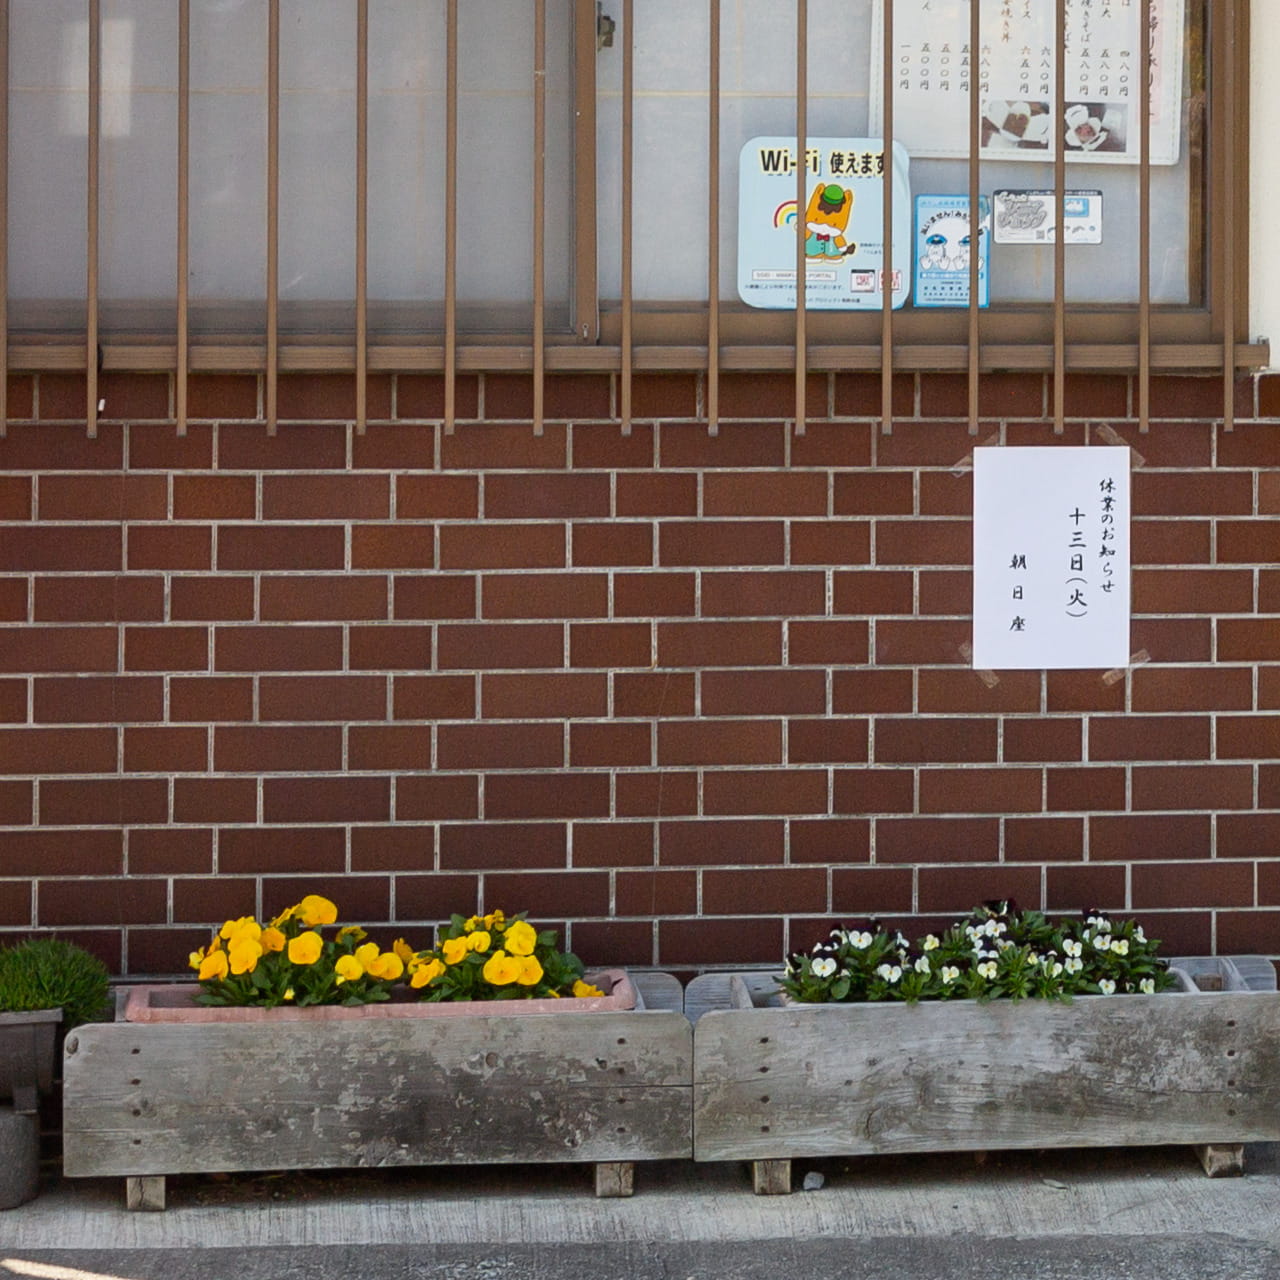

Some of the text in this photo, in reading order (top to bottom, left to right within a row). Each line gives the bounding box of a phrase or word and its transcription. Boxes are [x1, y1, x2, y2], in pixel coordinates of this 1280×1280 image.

[1079, 47, 1090, 97] 五八〇円
[1098, 48, 1111, 97] 五八〇円
[1065, 507, 1088, 618] 十三日（火）
[1097, 476, 1117, 594] 休業のお知らせ
[1008, 552, 1028, 632] 朝日座
